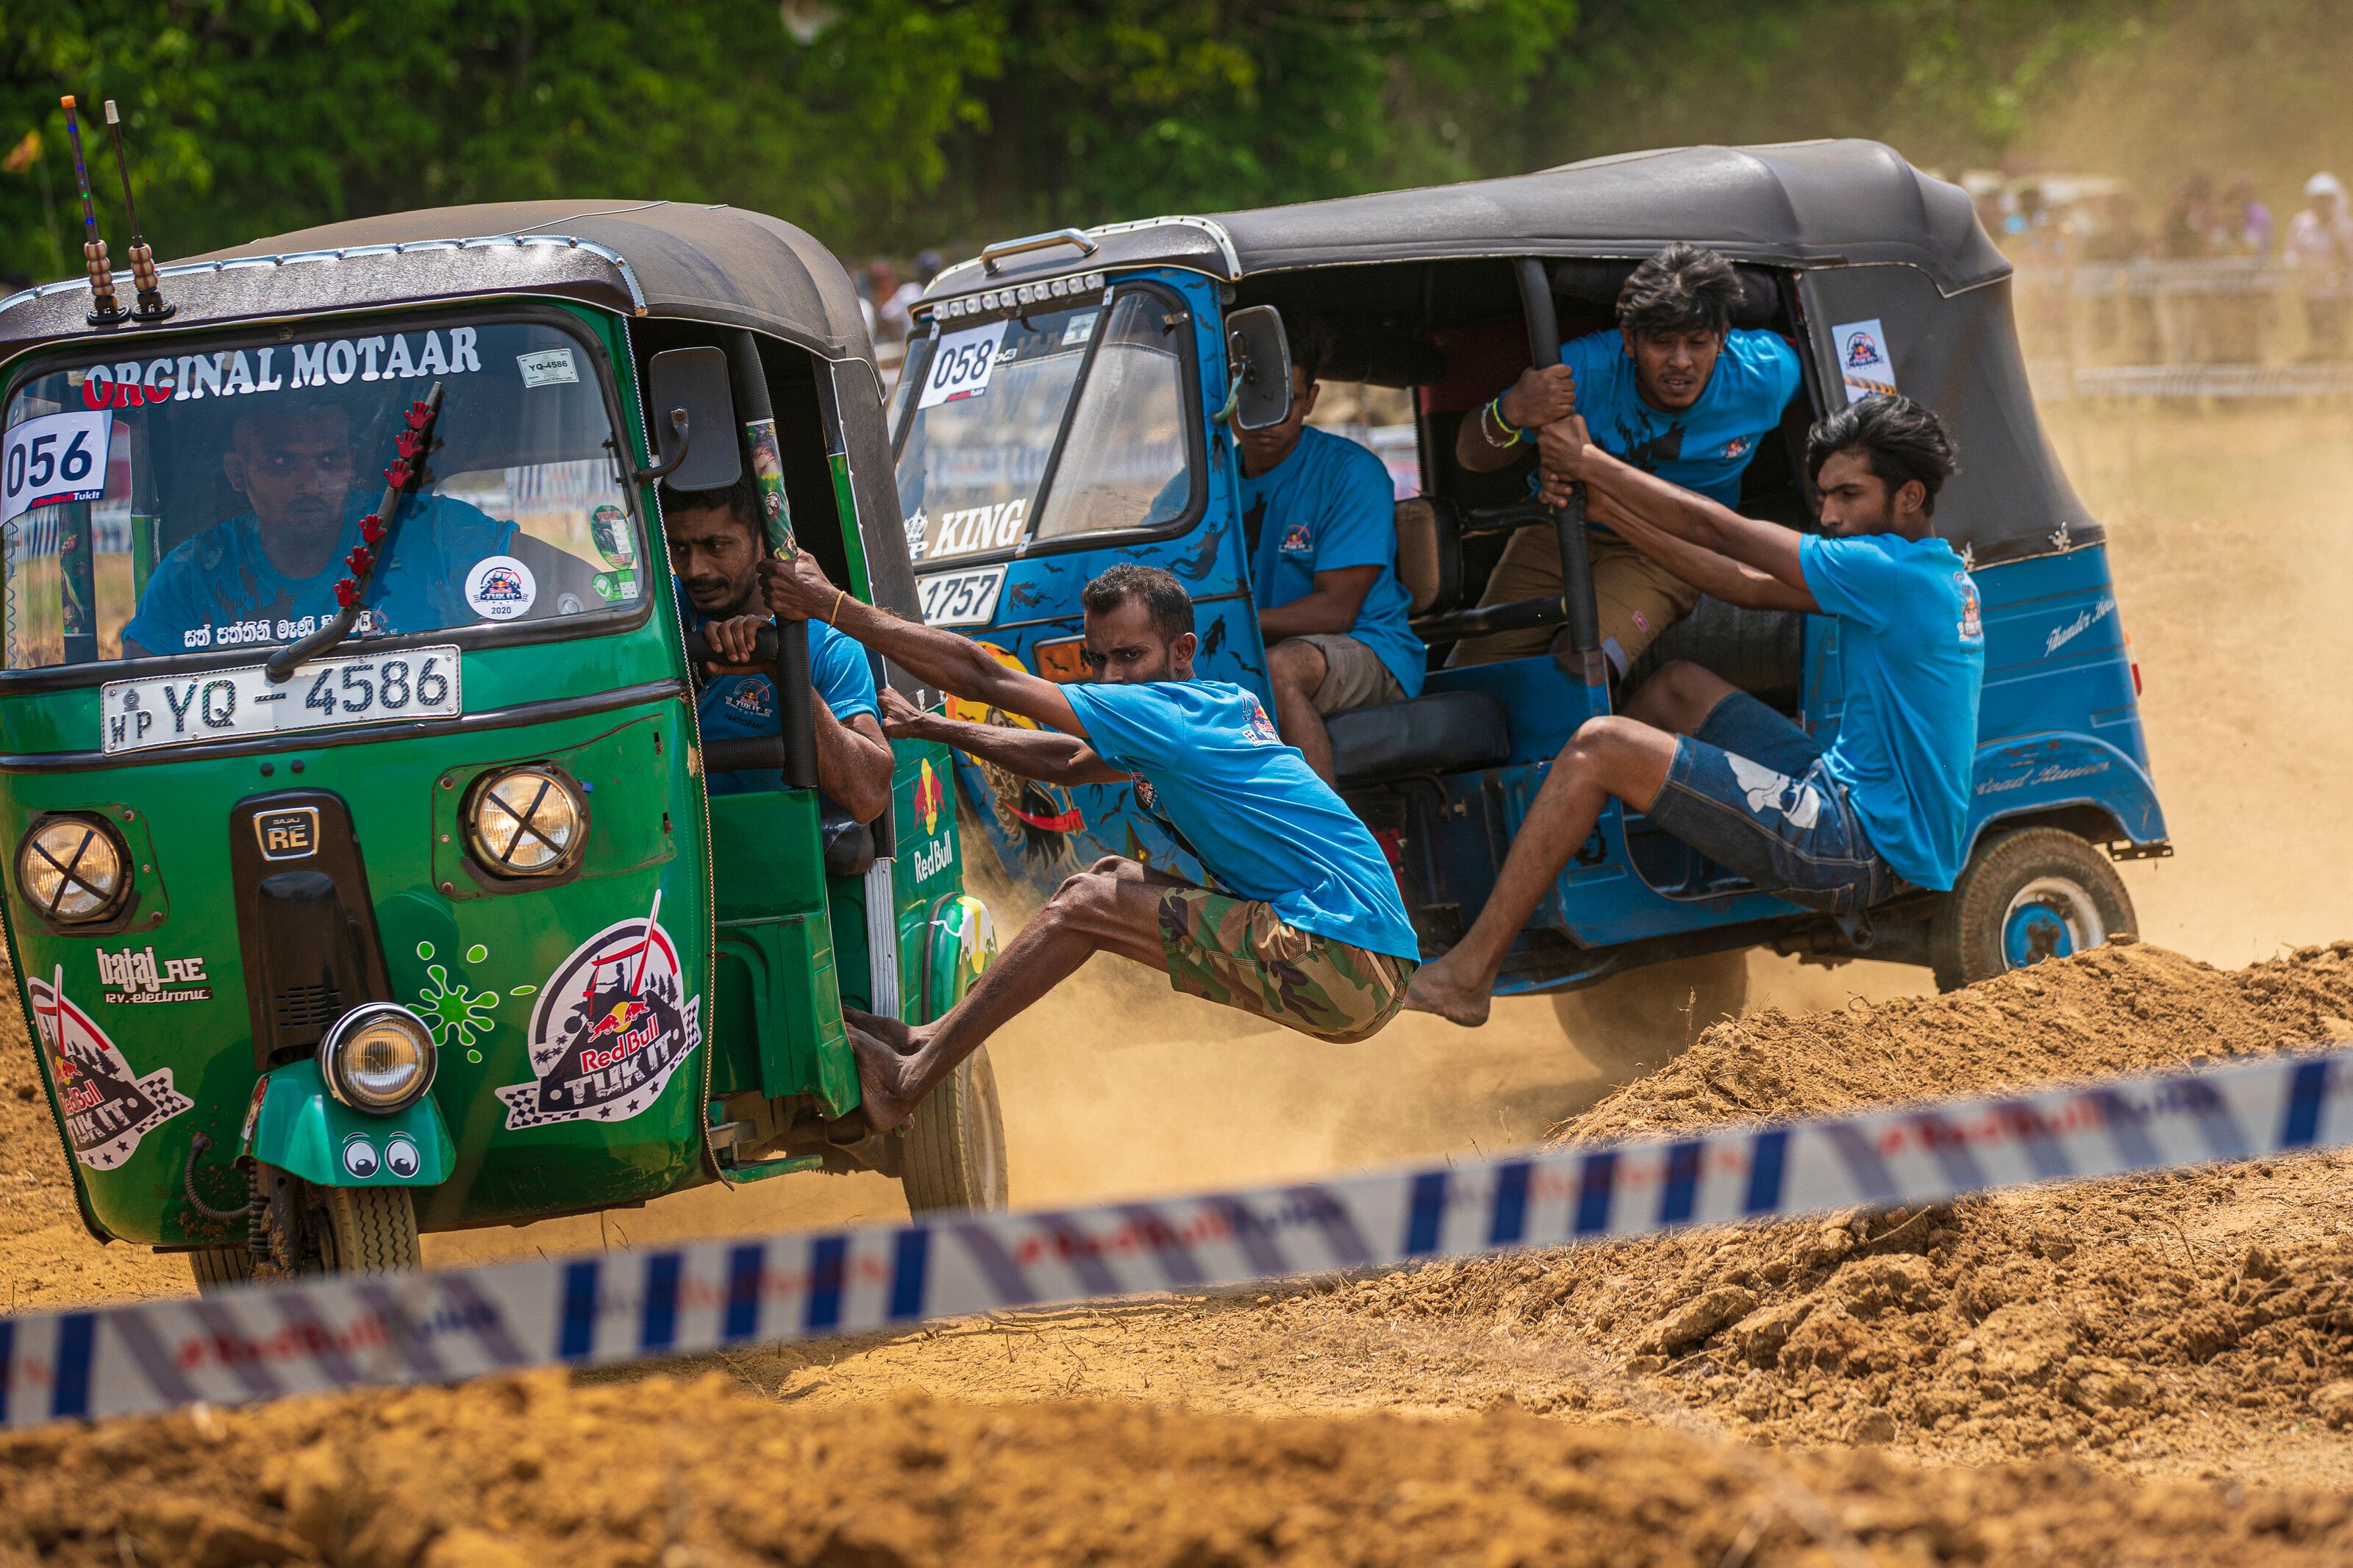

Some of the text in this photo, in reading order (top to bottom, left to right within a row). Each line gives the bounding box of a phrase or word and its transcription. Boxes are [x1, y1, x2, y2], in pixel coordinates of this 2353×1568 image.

[82, 326, 481, 410] ORGINAL MOTAAR
[934, 339, 993, 389] 058
[7, 431, 93, 498] 056
[929, 498, 1027, 557] KING
[923, 574, 998, 620] 1757
[305, 657, 449, 716] 4586
[724, 713, 765, 730] PARTICIPANT
[268, 824, 308, 850] RE
[96, 946, 207, 992] bajaj RE
[564, 1029, 671, 1105] TUK IT
[95, 1098, 131, 1131] IT
